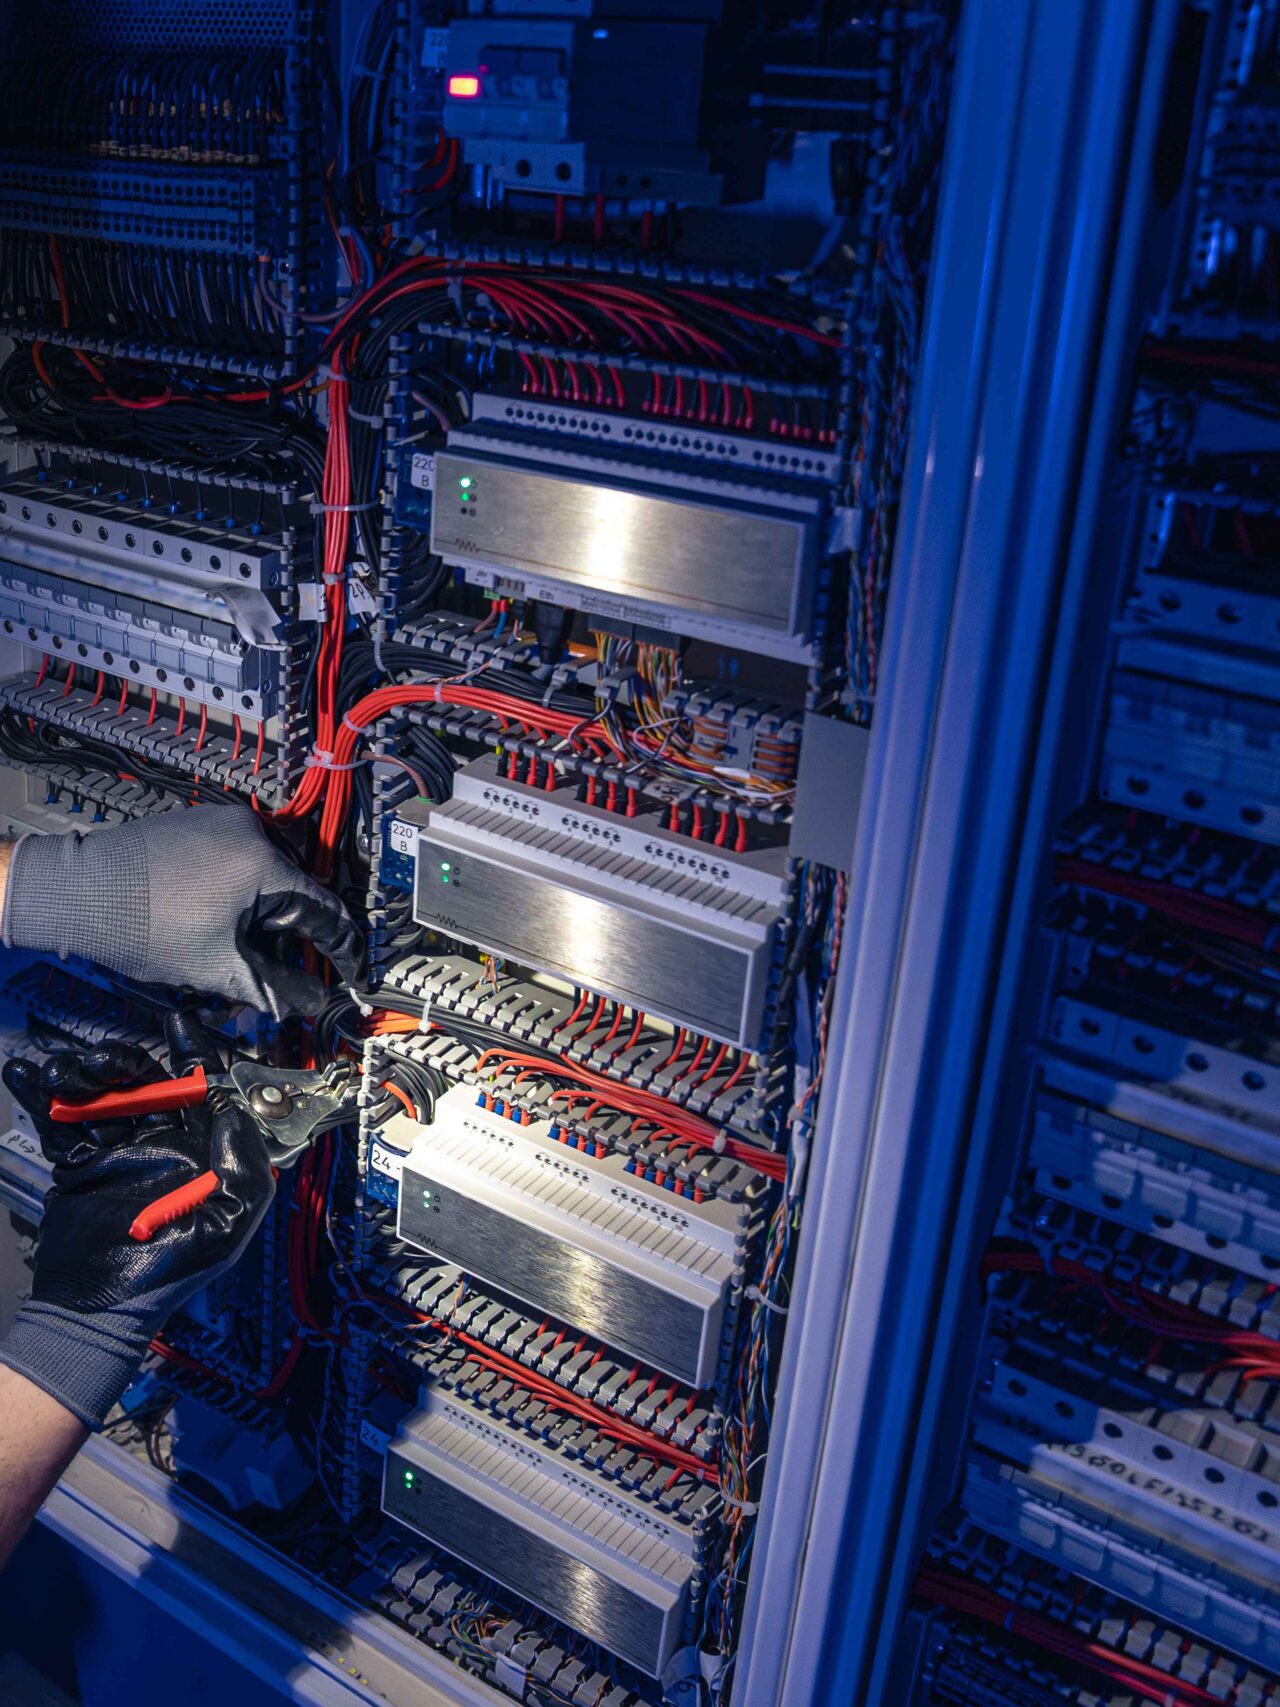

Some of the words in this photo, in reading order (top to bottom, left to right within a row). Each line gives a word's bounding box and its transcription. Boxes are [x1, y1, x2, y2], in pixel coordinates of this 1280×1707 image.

[421, 474, 429, 488] B
[539, 589, 554, 601] Eth
[393, 823, 413, 839] 220
[400, 840, 408, 852] B
[373, 1149, 391, 1170] 24
[362, 1425, 378, 1445] 24
